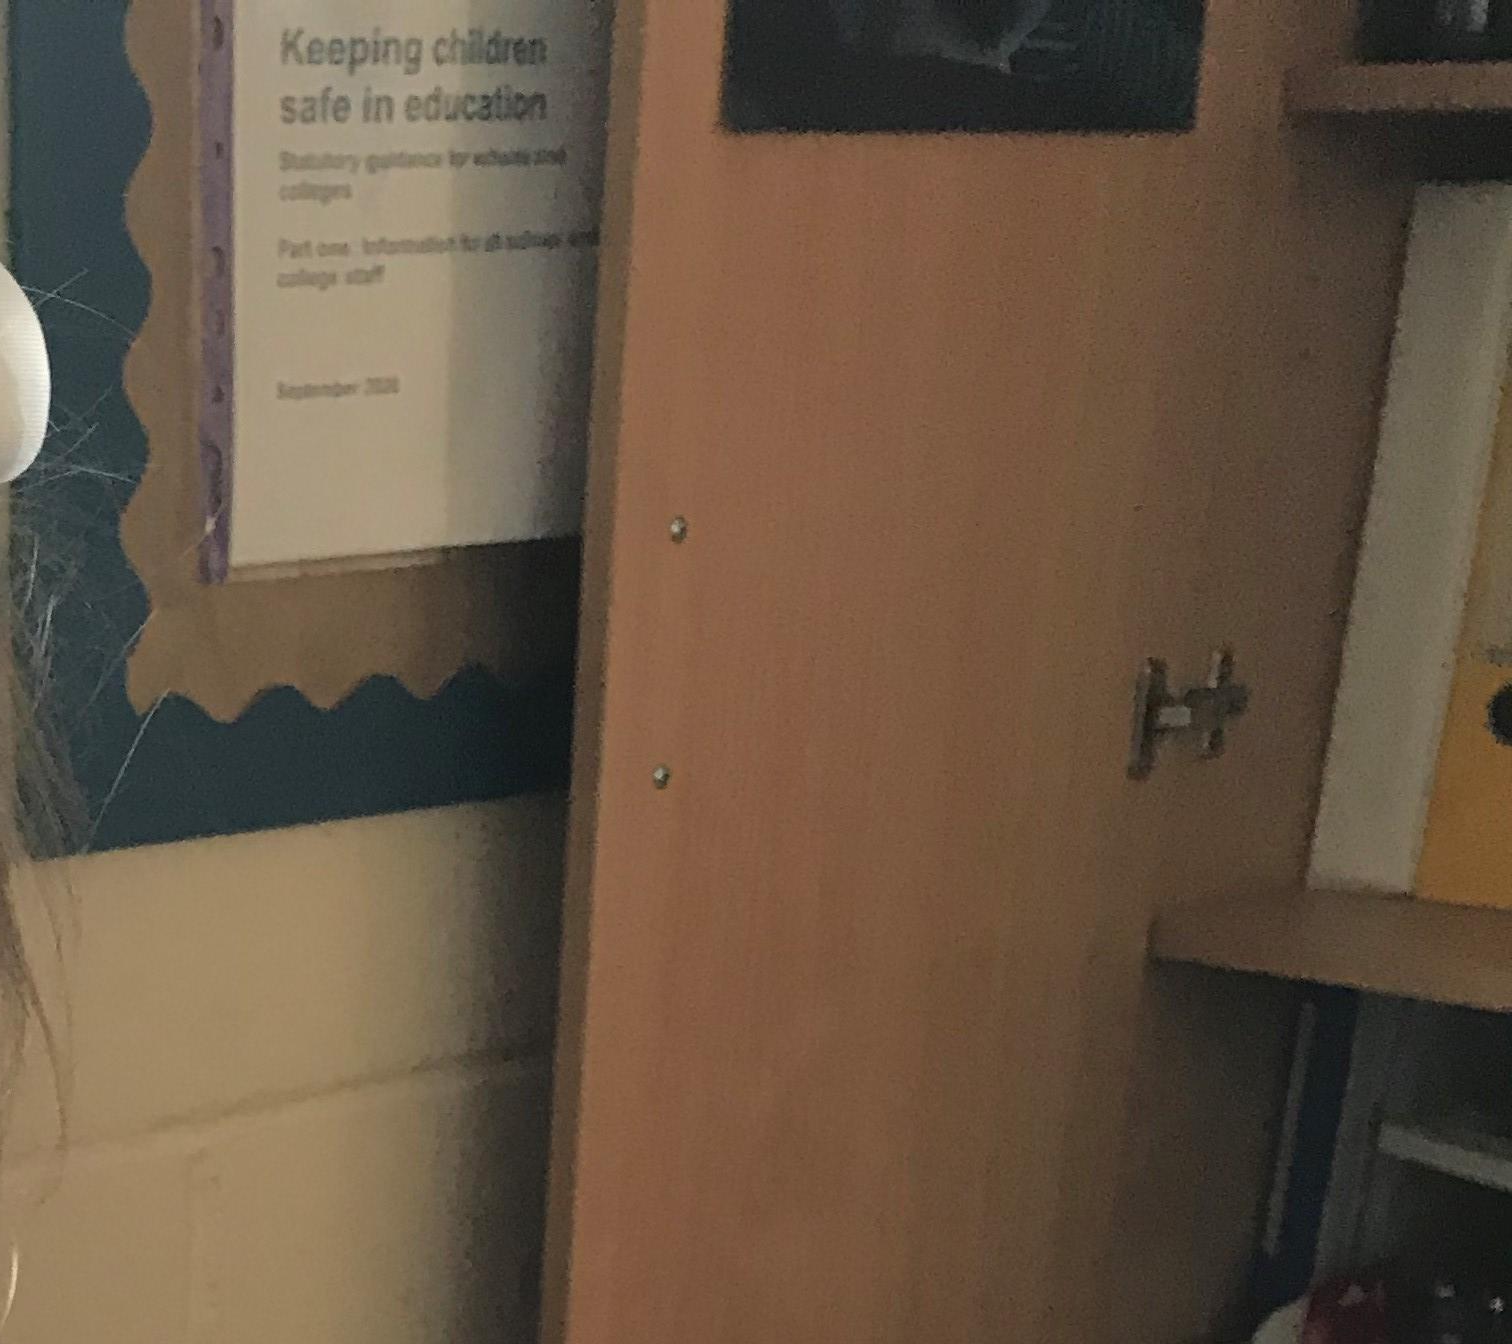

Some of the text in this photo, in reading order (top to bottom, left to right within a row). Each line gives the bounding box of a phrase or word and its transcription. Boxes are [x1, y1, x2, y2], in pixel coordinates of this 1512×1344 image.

[279, 26, 548, 75] Keeping children
[279, 84, 548, 124] safe in education
